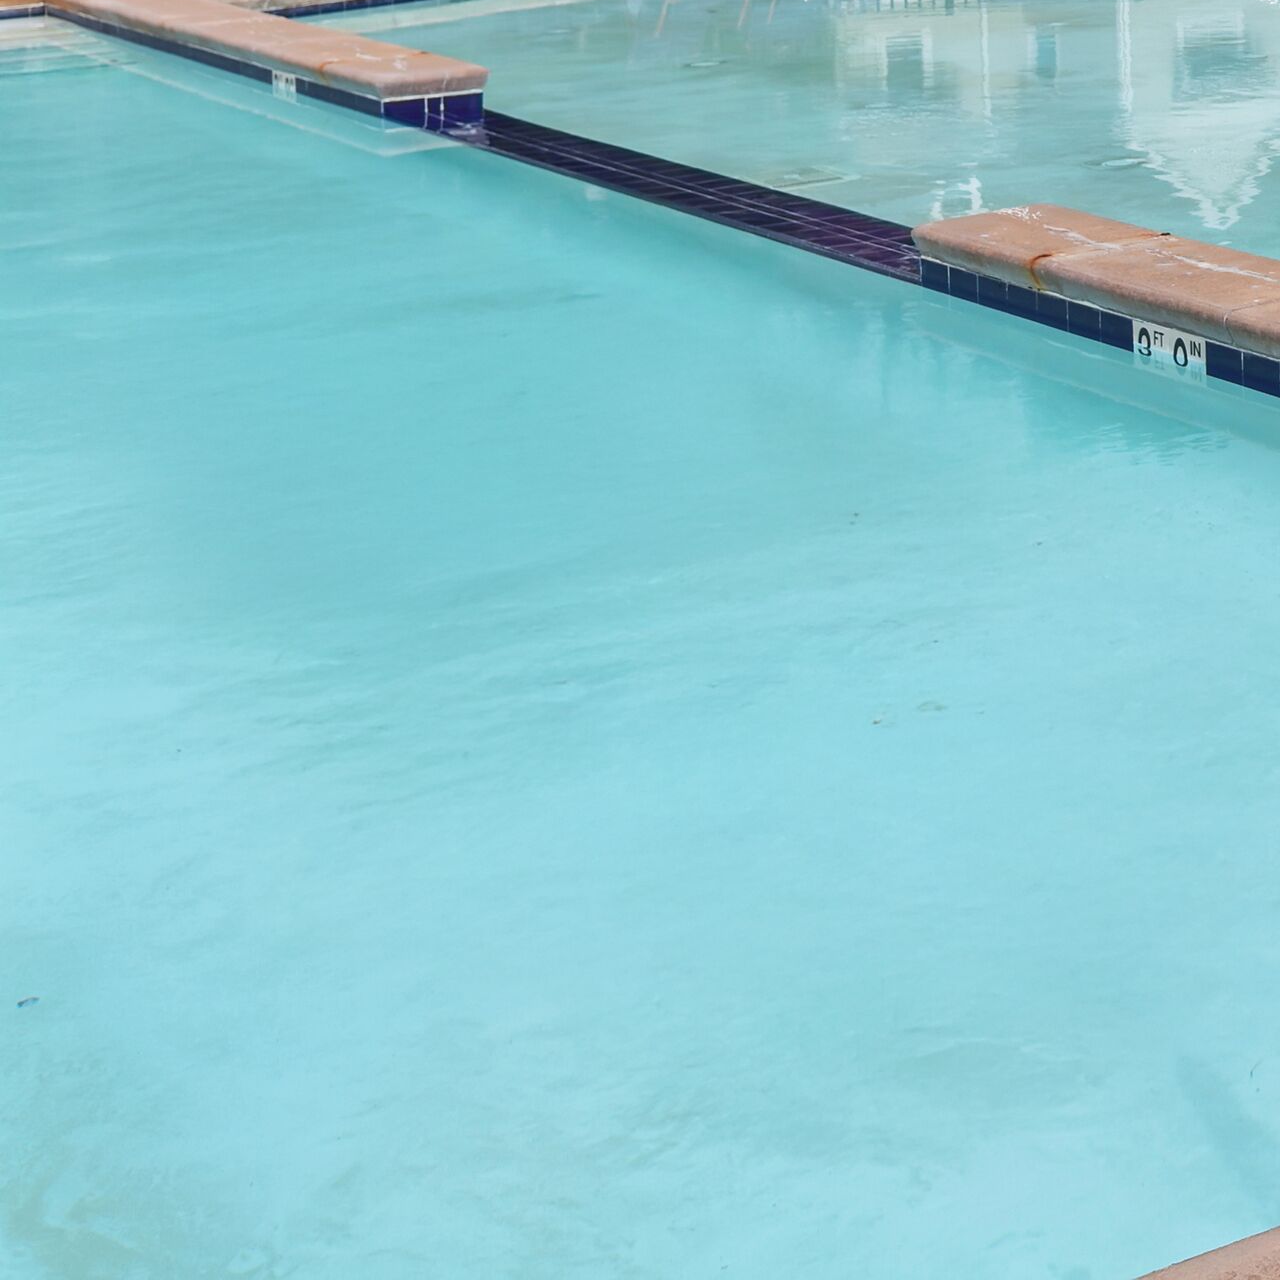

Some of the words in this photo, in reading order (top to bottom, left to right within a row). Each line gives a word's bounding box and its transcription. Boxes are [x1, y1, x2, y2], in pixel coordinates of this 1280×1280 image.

[1153, 330, 1165, 348] FT
[1173, 337, 1189, 368] 0
[1189, 340, 1202, 359] IN
